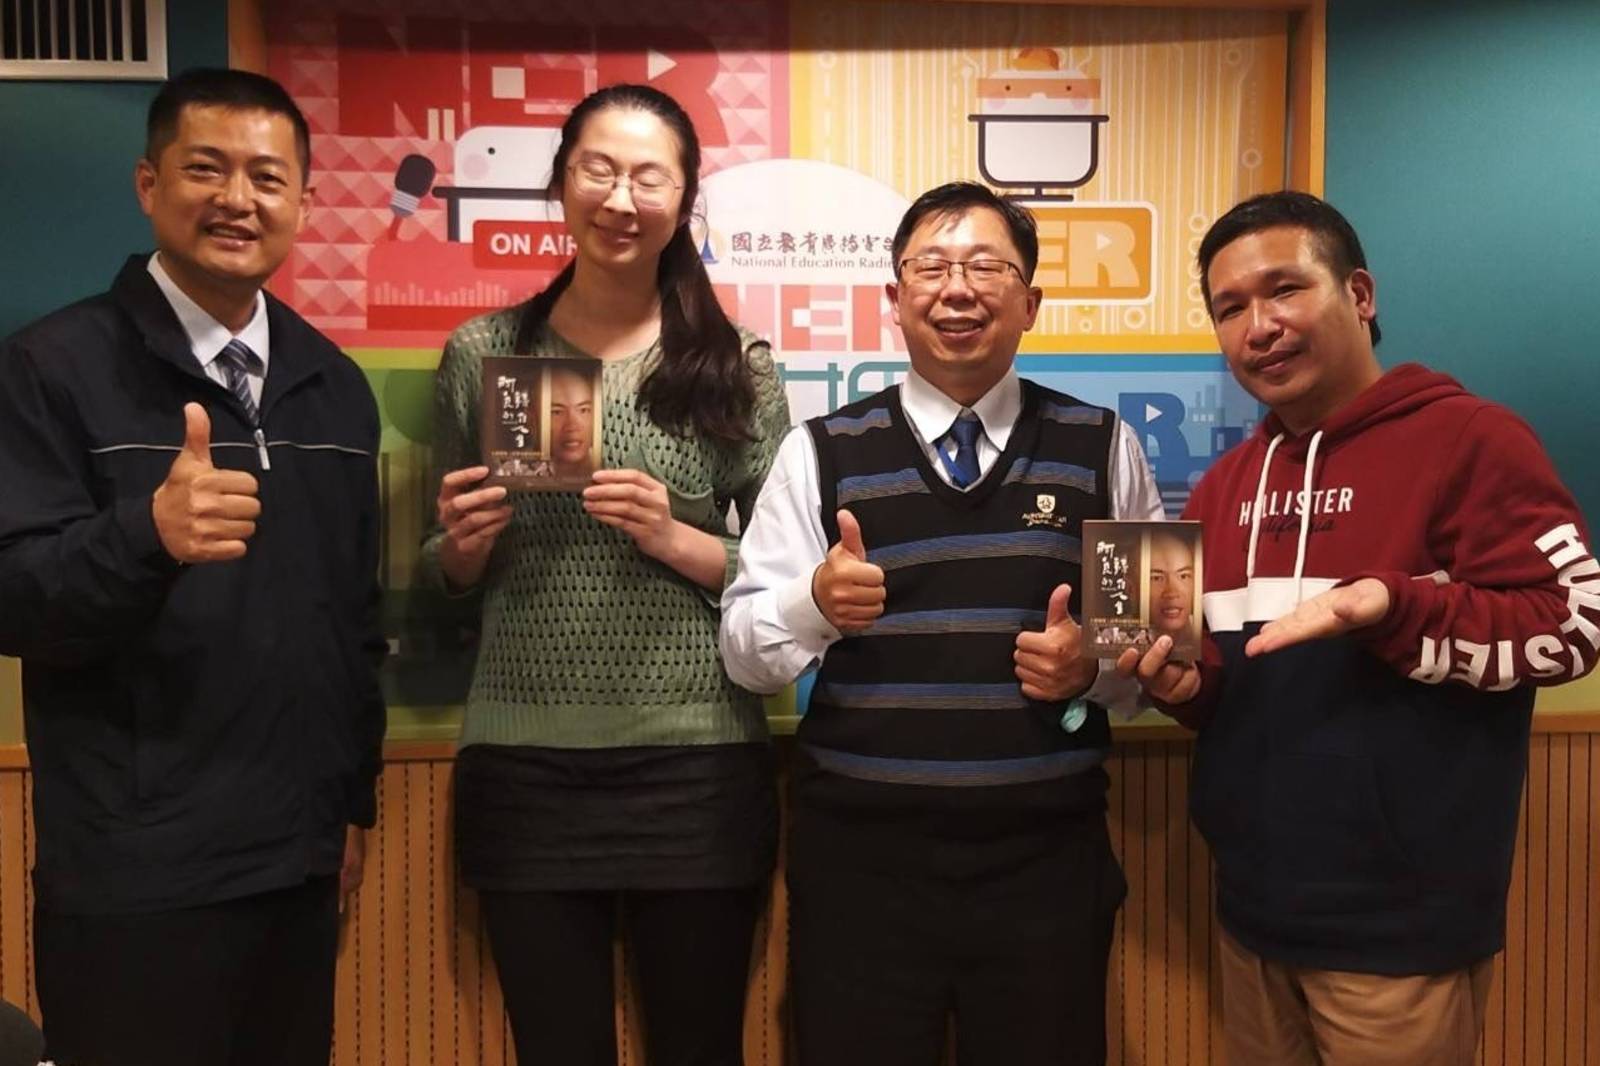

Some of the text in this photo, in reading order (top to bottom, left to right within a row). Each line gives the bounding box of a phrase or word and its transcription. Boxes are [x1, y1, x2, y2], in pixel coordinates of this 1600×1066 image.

[490, 232, 531, 255] ON
[732, 256, 894, 269] National Education Radi
[1238, 486, 1355, 527] HLLISTER
